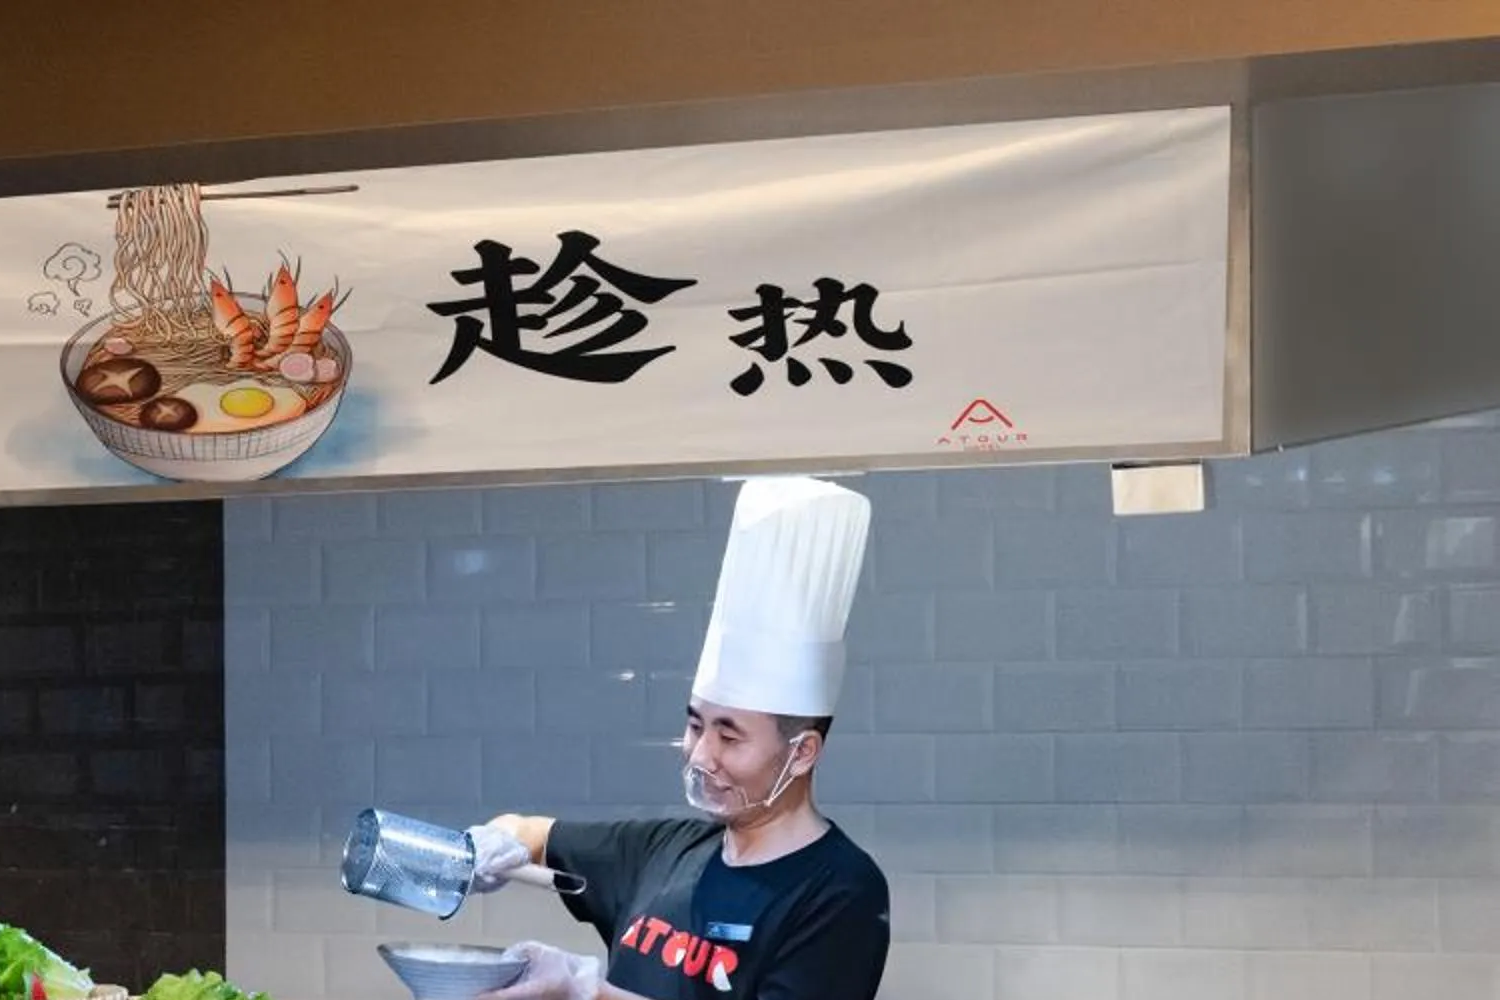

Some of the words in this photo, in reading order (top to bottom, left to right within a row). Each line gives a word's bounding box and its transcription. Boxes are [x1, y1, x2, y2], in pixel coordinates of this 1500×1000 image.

[426, 230, 914, 397] 趁热
[937, 433, 1028, 444] ATOUR
[620, 914, 740, 993] ATOUR
